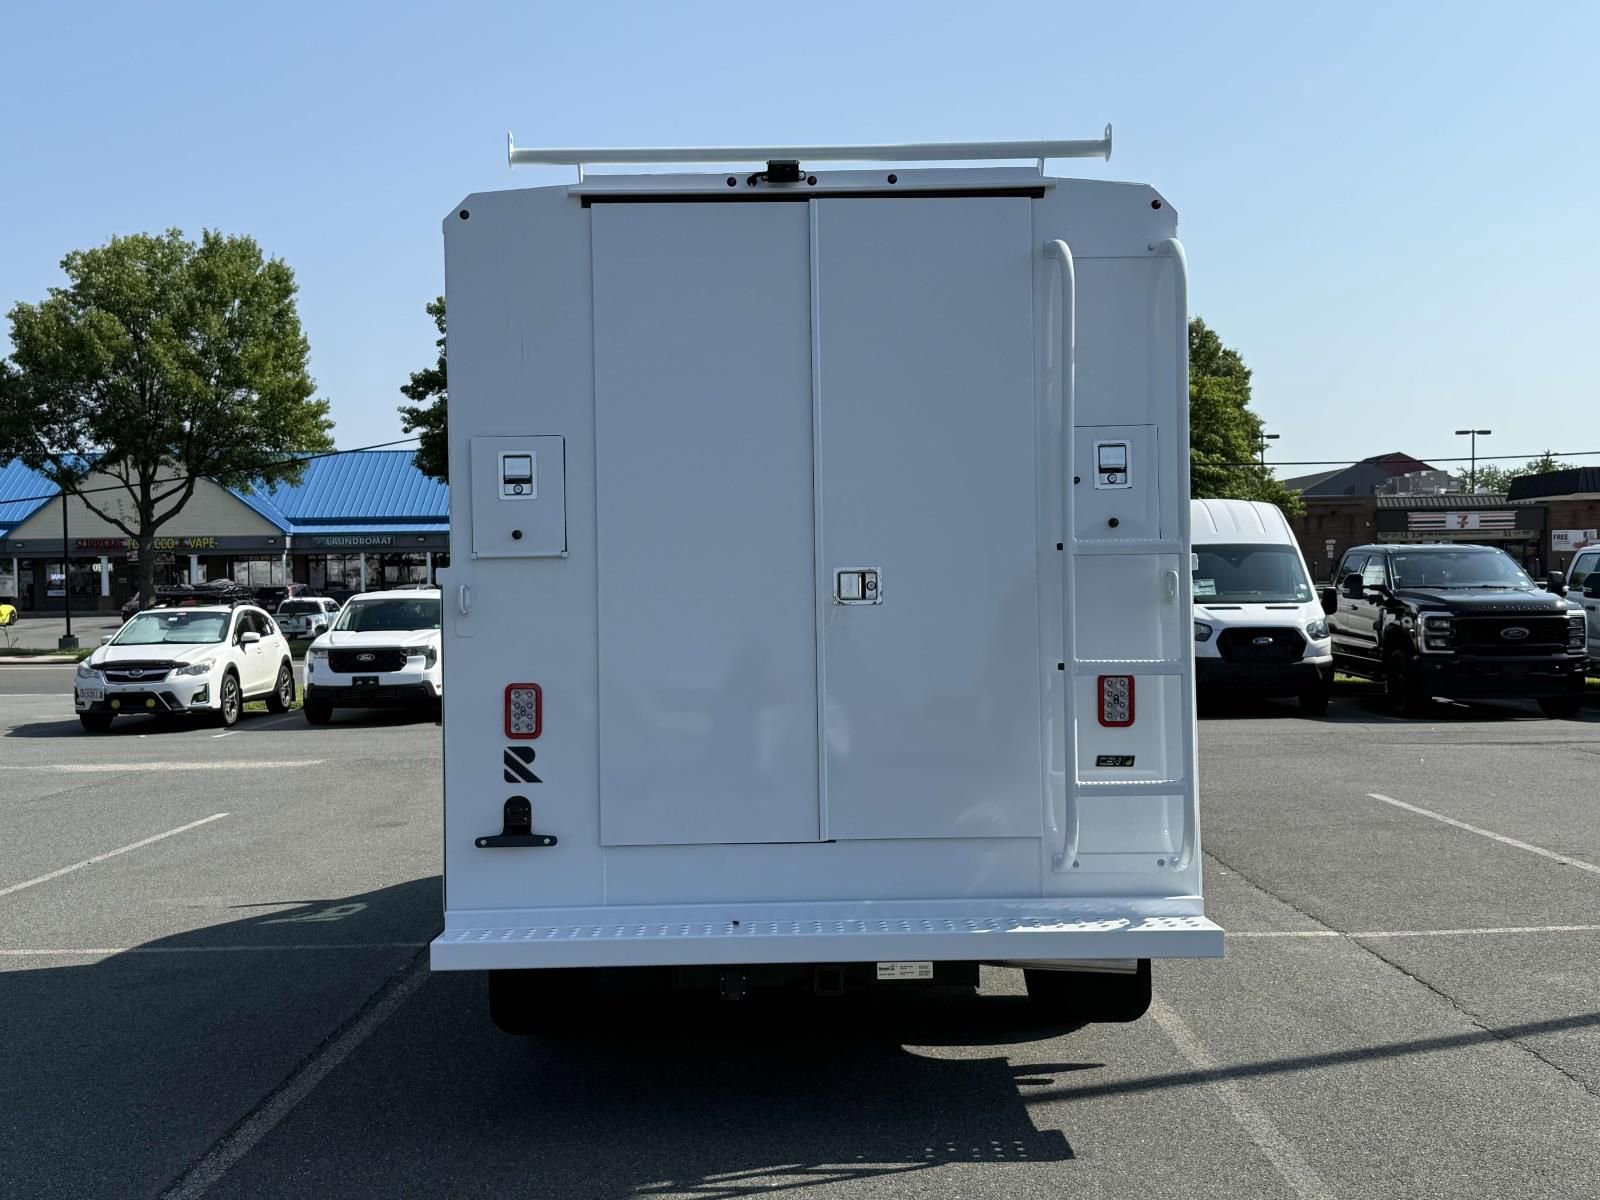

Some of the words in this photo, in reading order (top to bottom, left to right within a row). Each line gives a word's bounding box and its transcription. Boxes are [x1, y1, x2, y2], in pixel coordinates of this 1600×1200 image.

[127, 537, 176, 549] TOCCO
[188, 537, 215, 548] VAPE
[326, 536, 392, 545] LAUNDROMAT
